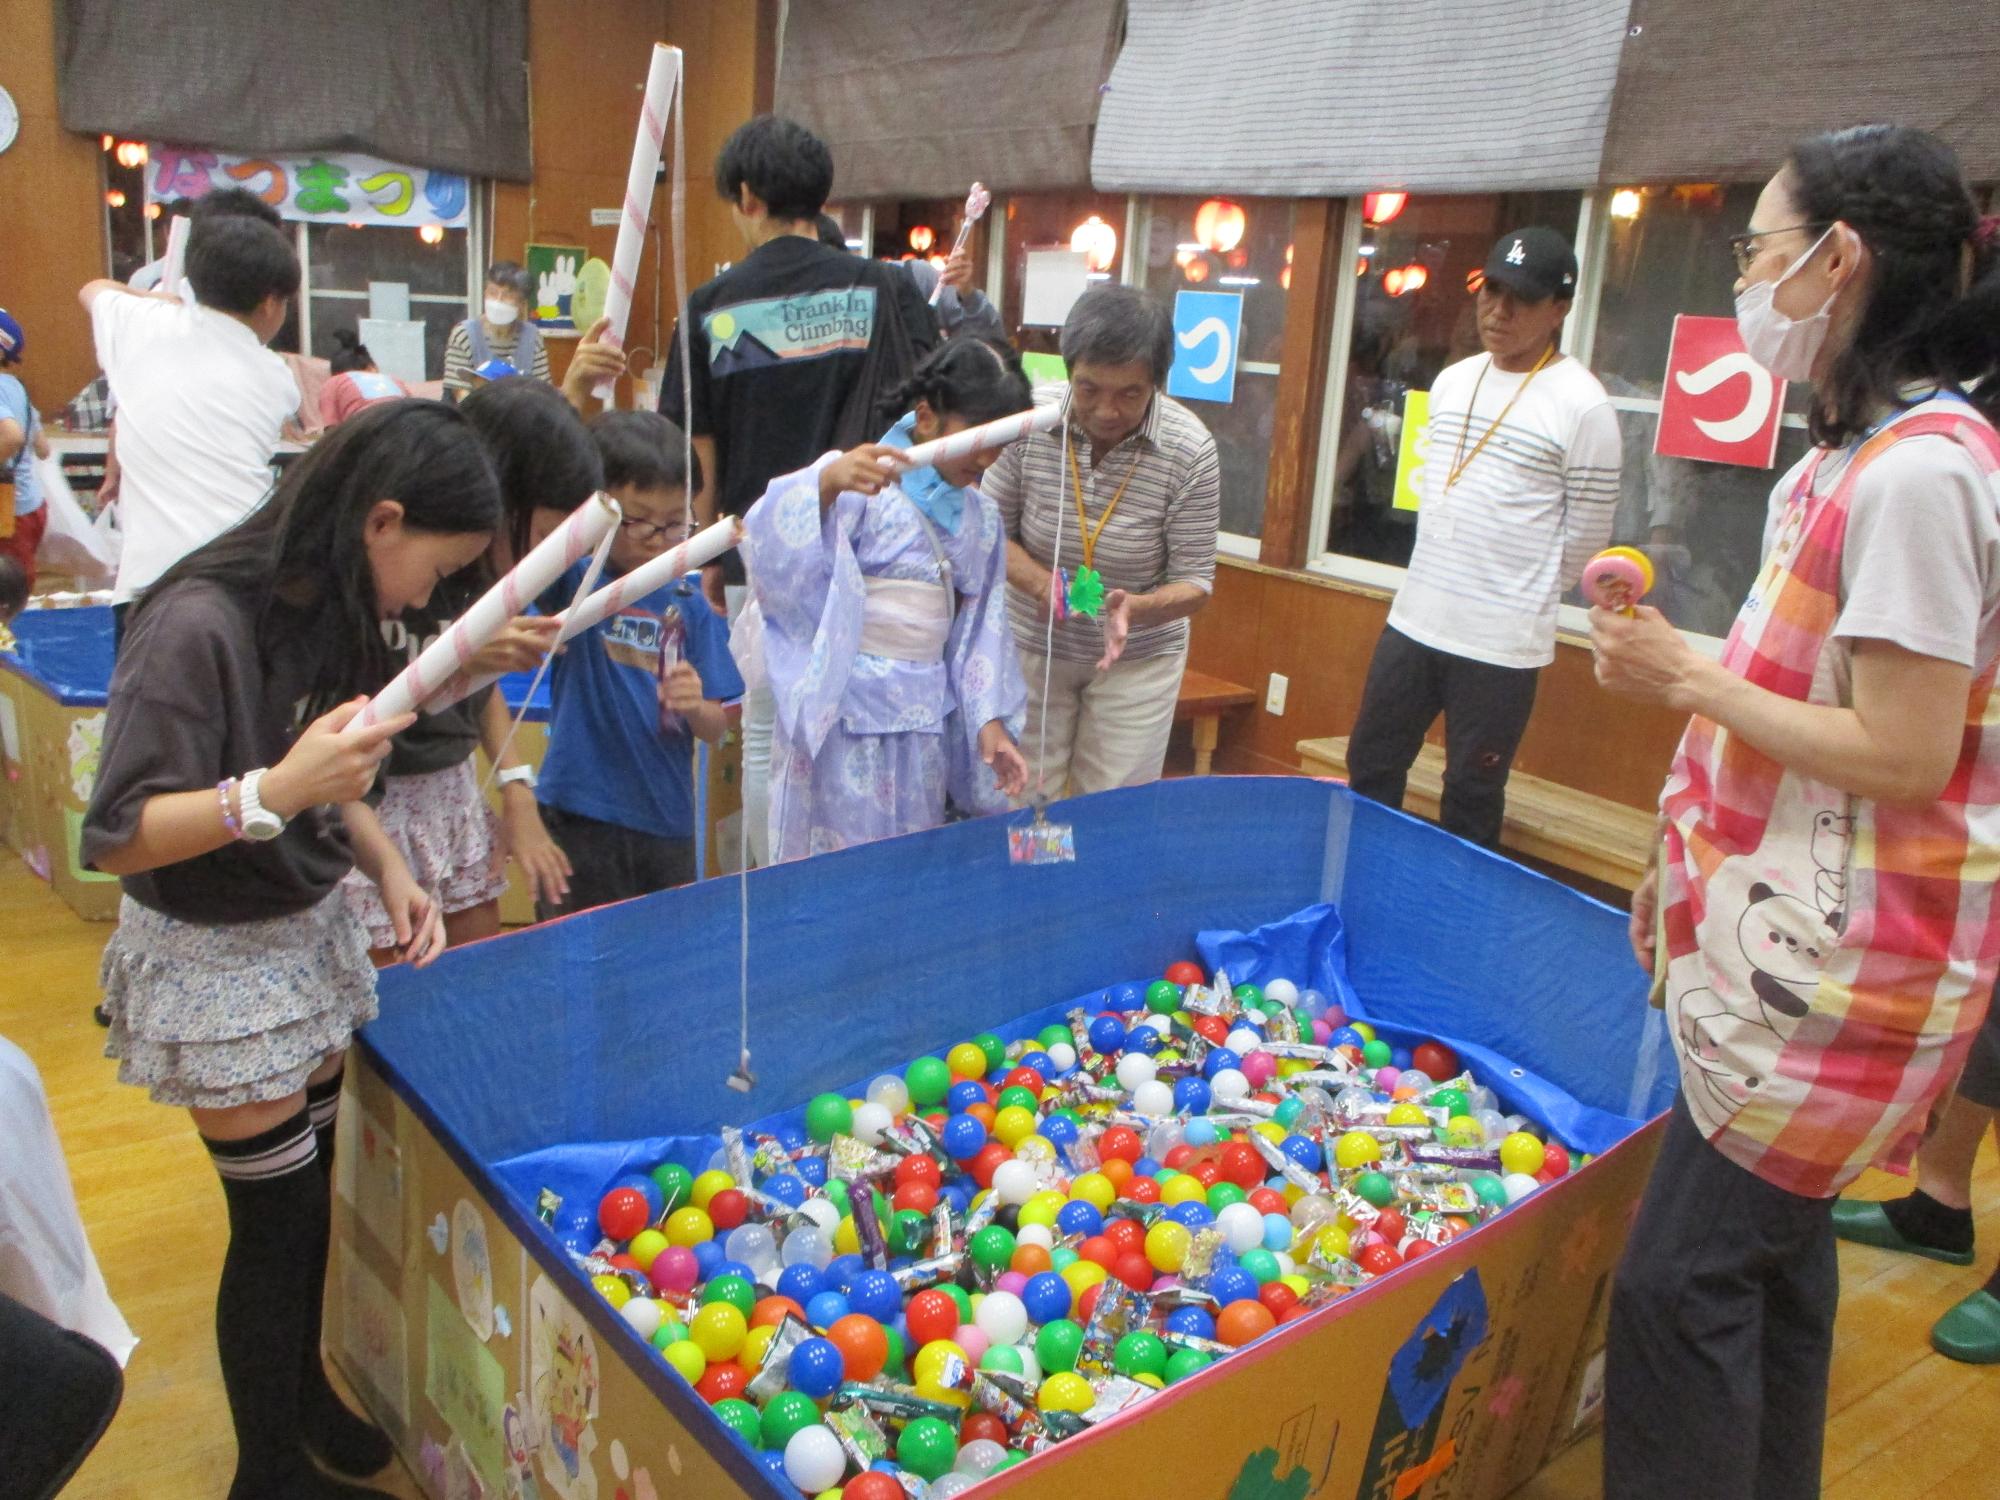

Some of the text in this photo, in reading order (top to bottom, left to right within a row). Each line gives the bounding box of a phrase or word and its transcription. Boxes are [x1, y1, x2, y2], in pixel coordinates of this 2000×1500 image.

[153, 149, 467, 220] なつまつり
[1505, 239, 1526, 265] LA
[783, 293, 867, 321] Frankln
[1178, 316, 1231, 384] つ
[1676, 352, 1773, 443] つ
